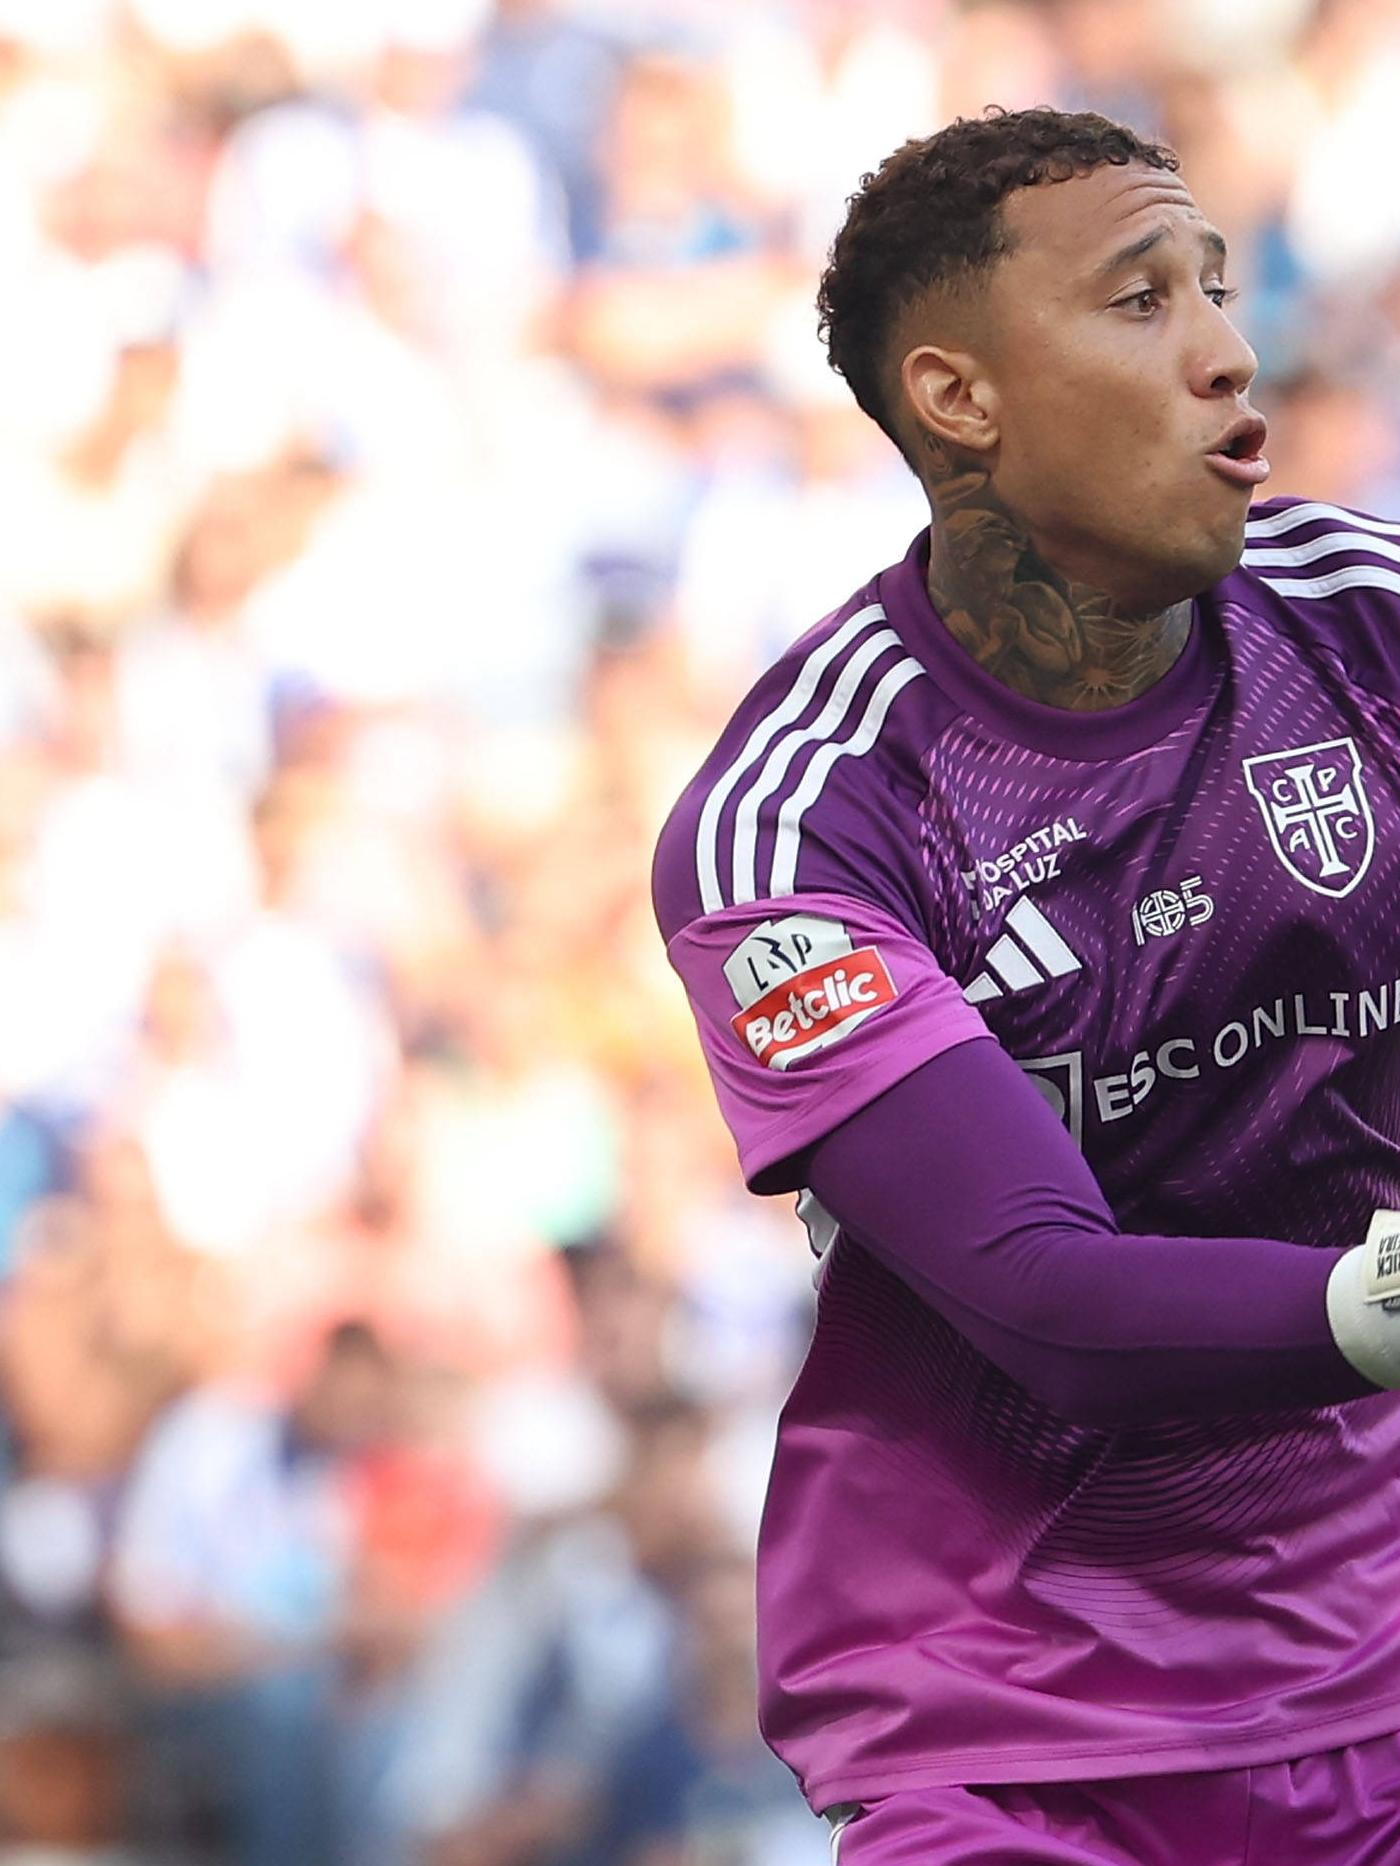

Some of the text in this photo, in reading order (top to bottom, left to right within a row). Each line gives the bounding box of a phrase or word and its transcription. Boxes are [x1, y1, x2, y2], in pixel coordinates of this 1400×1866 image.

[1008, 853, 1062, 892] LUZ
[745, 968, 878, 1058] Betclic
[1093, 1037, 1200, 1124] ESC
